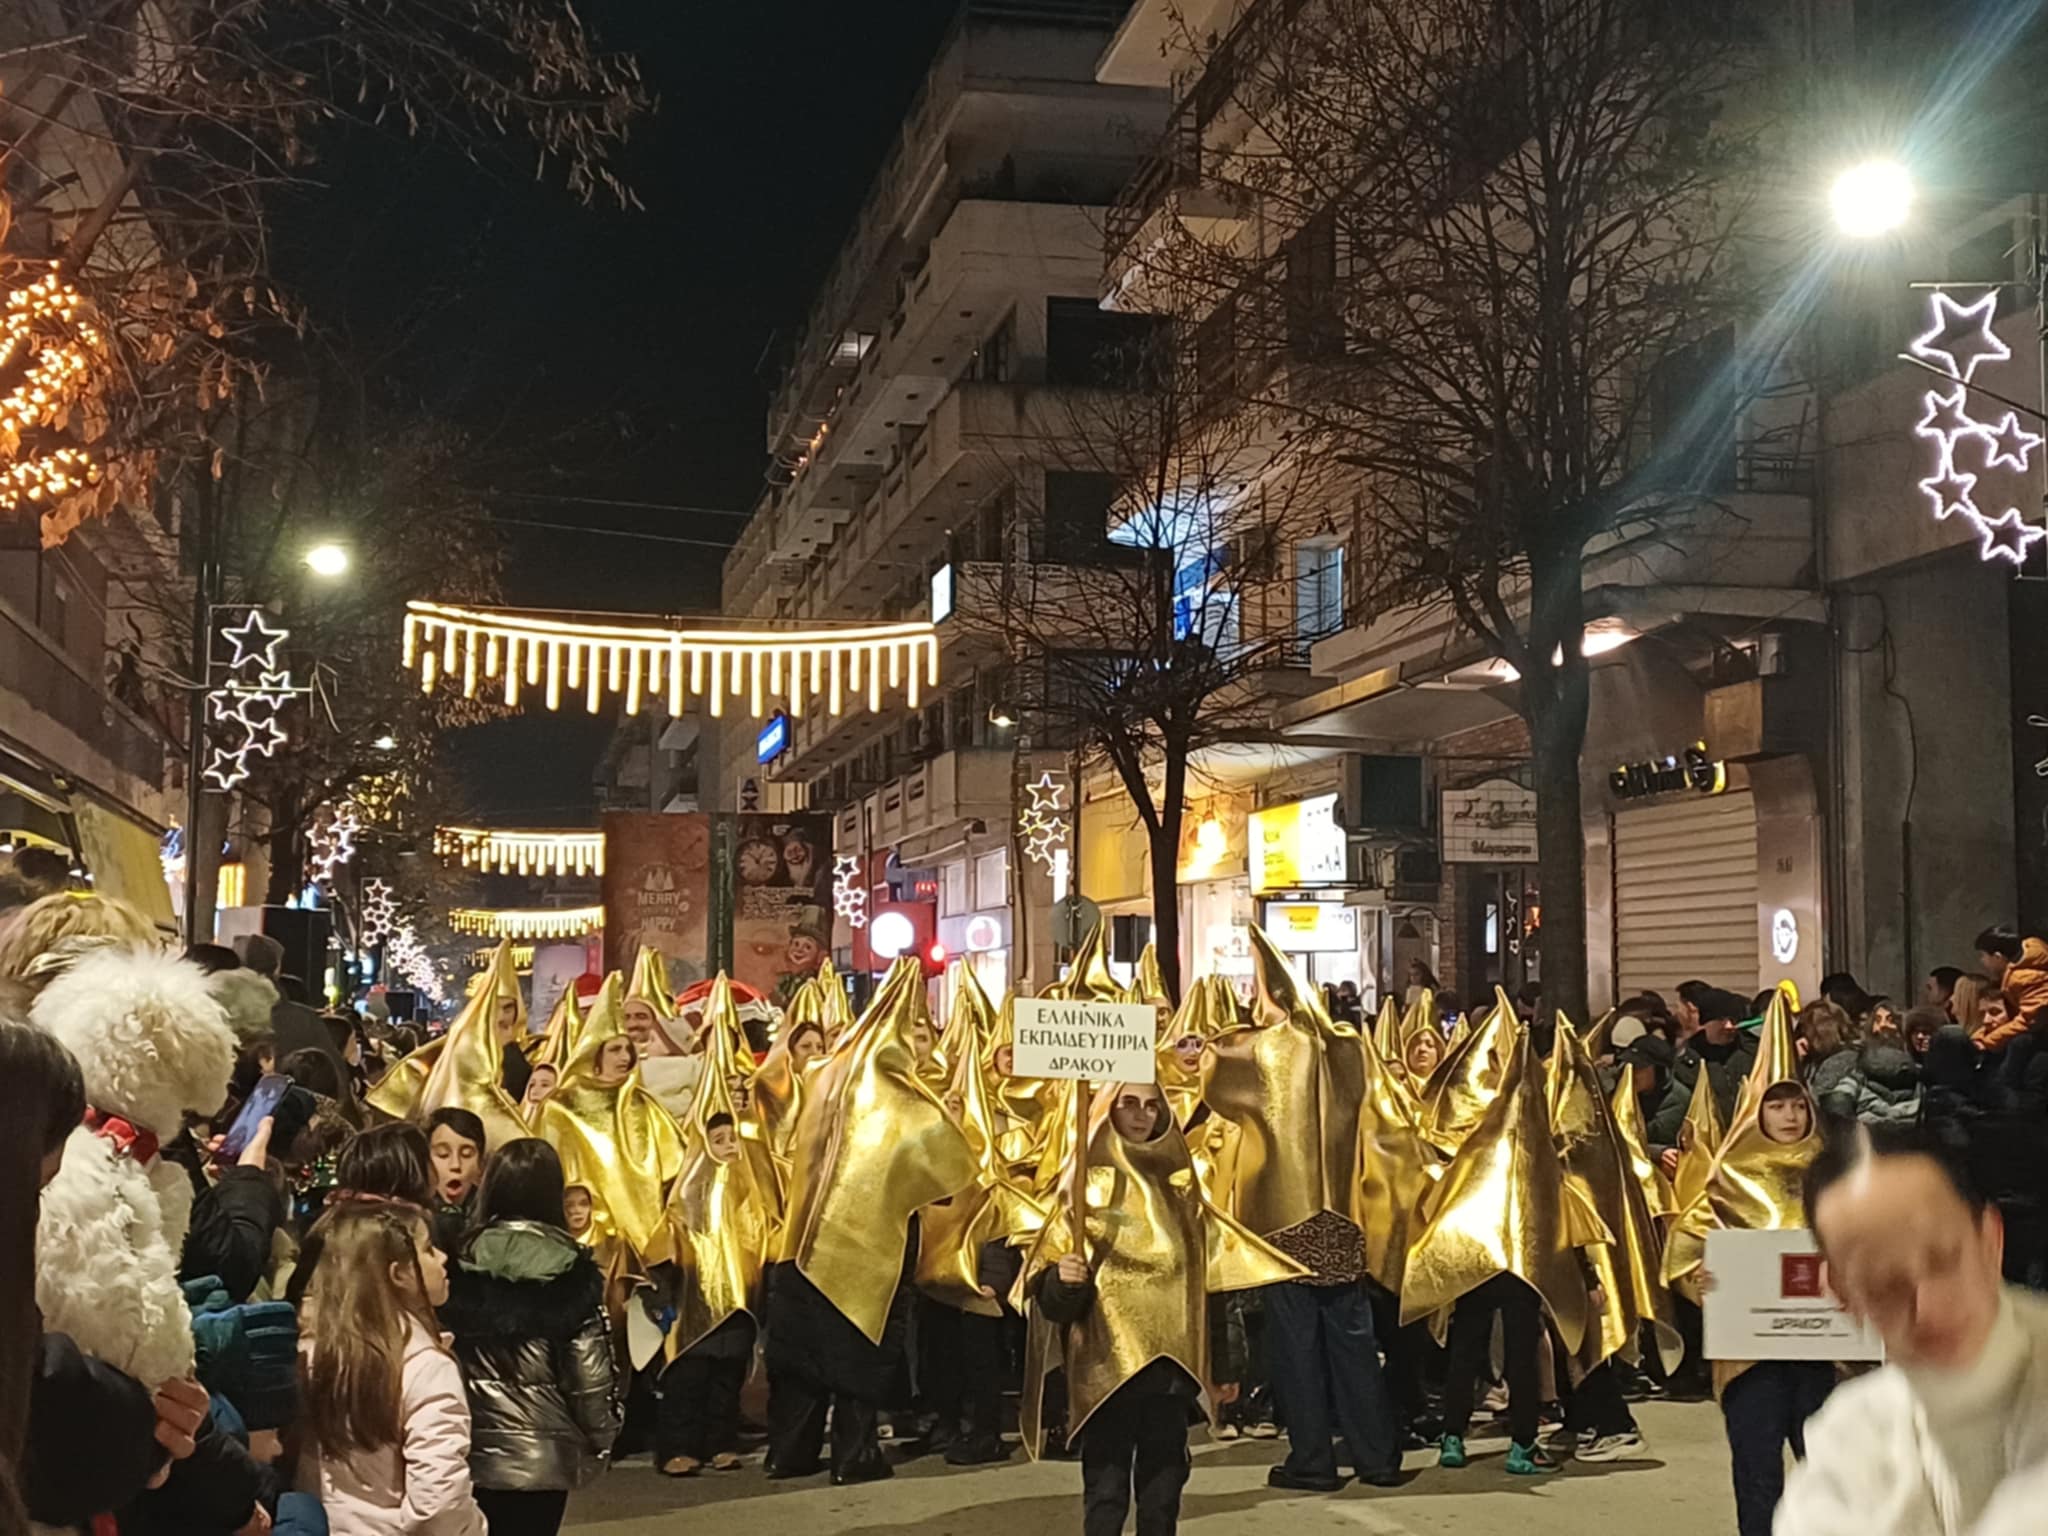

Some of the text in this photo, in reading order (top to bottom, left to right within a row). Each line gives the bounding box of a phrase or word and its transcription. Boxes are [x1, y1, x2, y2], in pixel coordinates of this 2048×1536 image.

[638, 891, 680, 905] MERRY
[1037, 1008, 1125, 1028] ΕΛΛΗΝΙΚΑ
[1019, 1029, 1149, 1051] ΕΚΠΑΙΔΕΥΤΗΡΙΑ
[1048, 1056, 1117, 1073] ΔΡΑΚΟΥ
